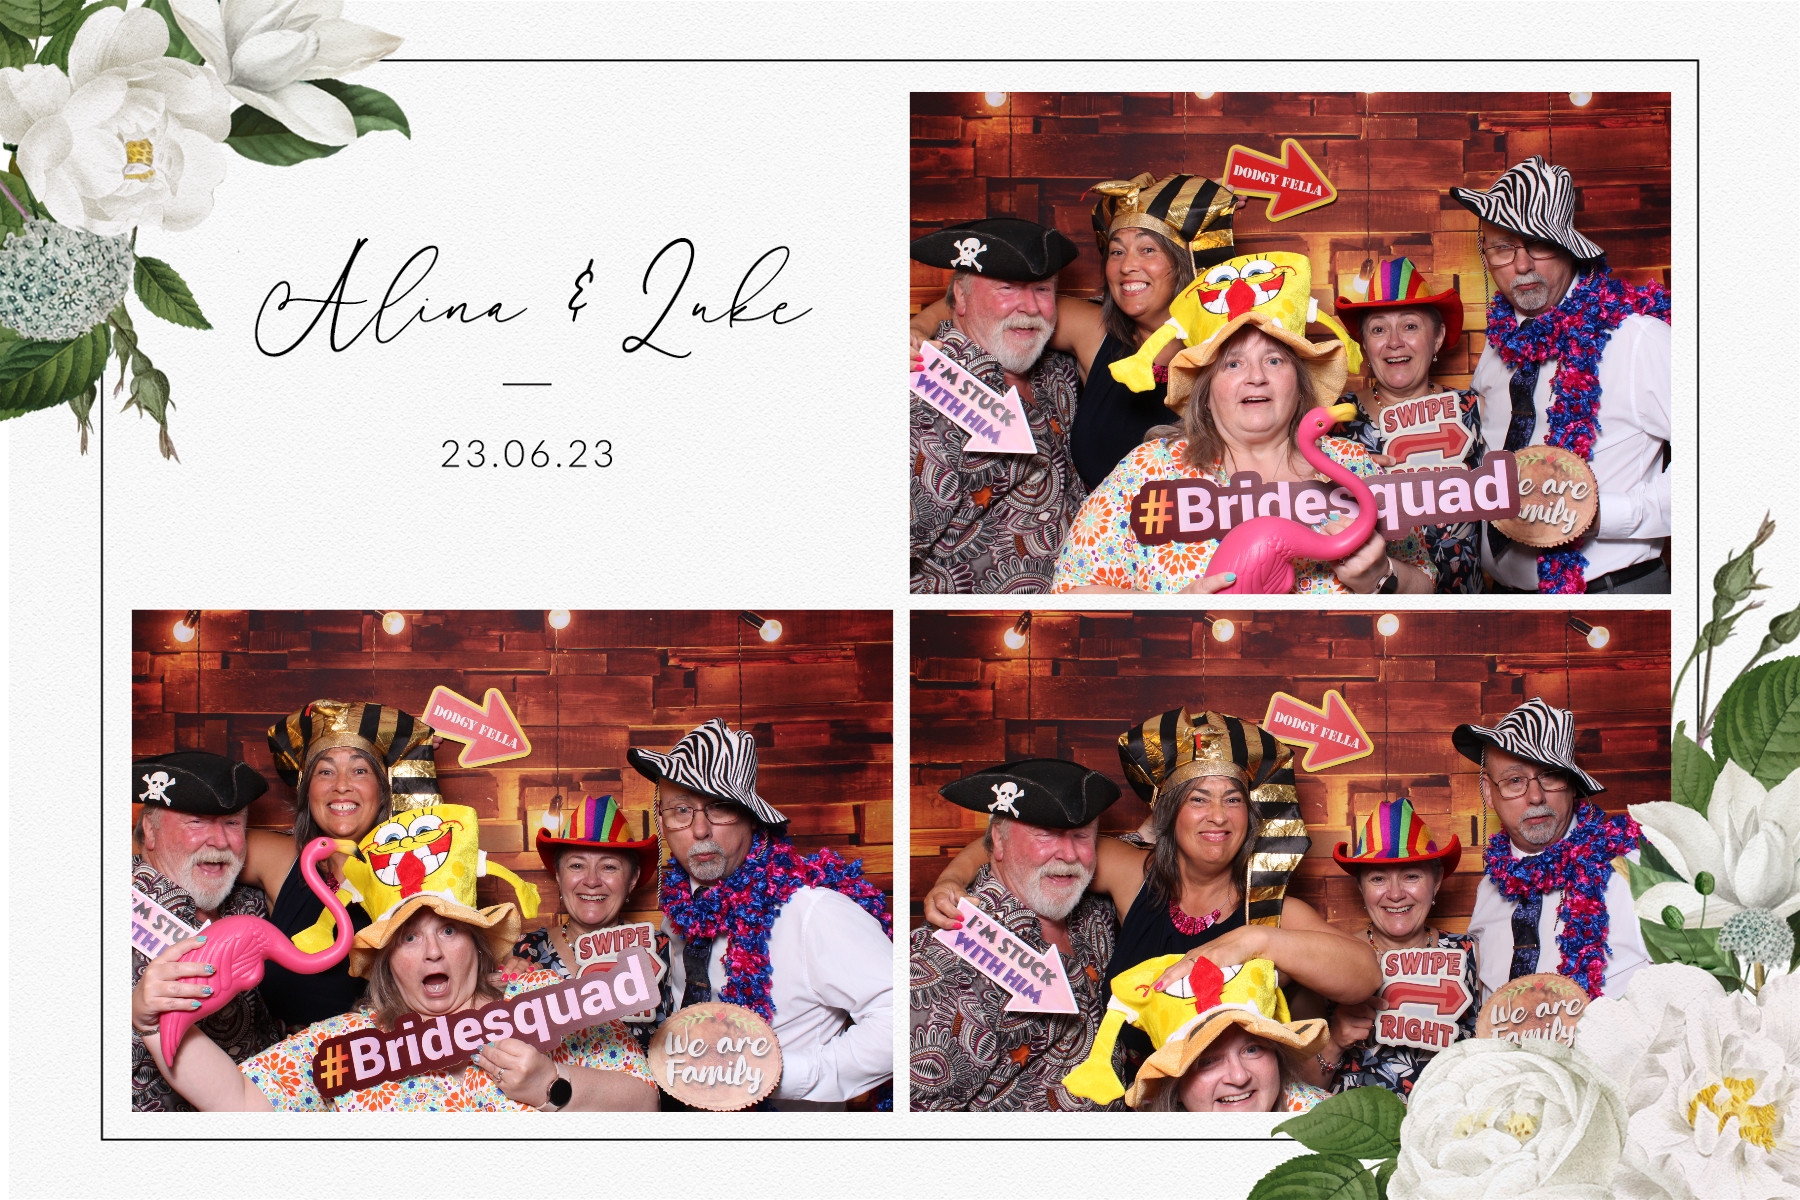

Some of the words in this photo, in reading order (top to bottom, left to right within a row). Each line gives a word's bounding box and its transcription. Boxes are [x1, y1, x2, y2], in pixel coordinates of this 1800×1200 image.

[1233, 164, 1279, 185] DODGY
[1281, 176, 1322, 196] FELLA
[916, 373, 967, 418] WITH
[962, 408, 1001, 445] HIM
[928, 357, 959, 386] I'M
[958, 379, 1016, 427] STUCK
[1383, 395, 1457, 433] SWIPE
[1541, 478, 1591, 500] are
[1518, 496, 1579, 534] mily
[433, 704, 478, 731] DODGY
[478, 723, 518, 750] FELLA
[1273, 711, 1319, 735] DODGY
[1320, 726, 1360, 749] FELLA
[132, 893, 152, 920] 'M
[152, 914, 190, 943] STU
[132, 921, 161, 953] TH
[579, 925, 651, 960] SWIPE
[966, 914, 998, 944] I'M
[997, 937, 1057, 986] STUCK
[954, 931, 1007, 977] WITH
[1002, 967, 1042, 1005] HIM
[1385, 951, 1461, 977] SWIPE
[320, 953, 650, 1090] #Bridesquad
[1380, 1014, 1454, 1047] RIGHT
[1490, 998, 1528, 1025] We
[1535, 998, 1584, 1018] are
[665, 1025, 708, 1057] We
[717, 1036, 772, 1057] are
[665, 1054, 764, 1094] Family
